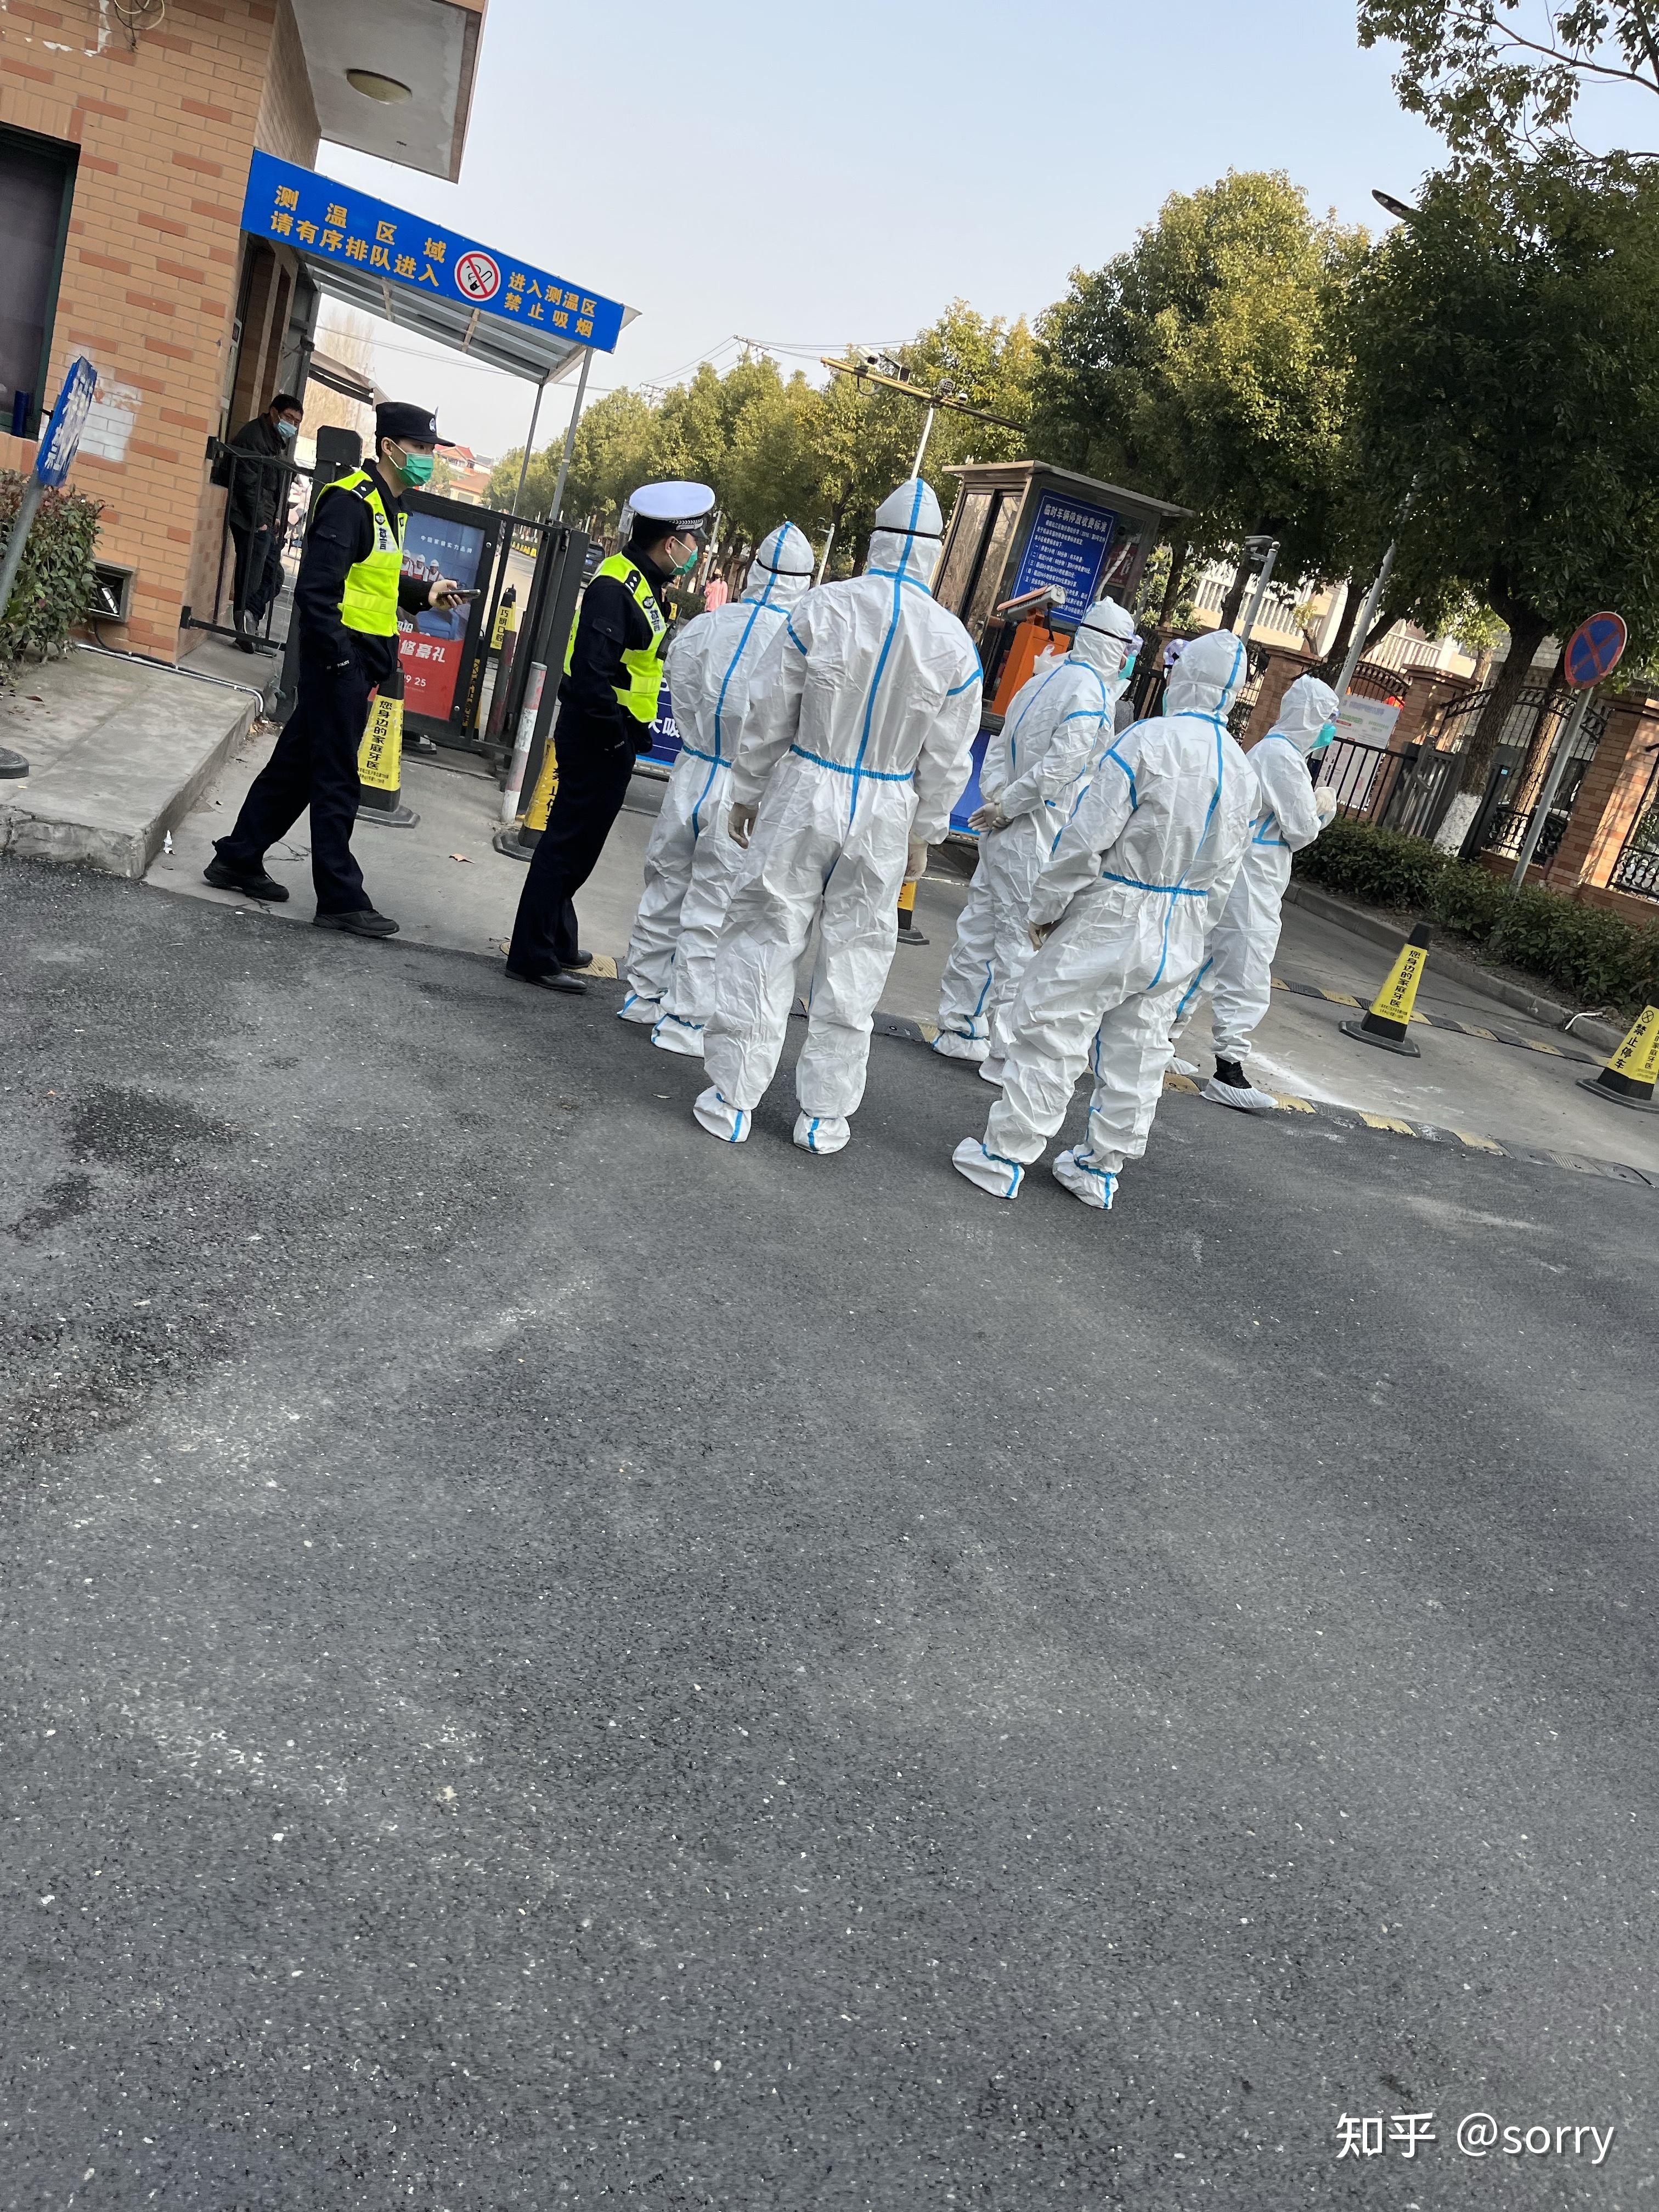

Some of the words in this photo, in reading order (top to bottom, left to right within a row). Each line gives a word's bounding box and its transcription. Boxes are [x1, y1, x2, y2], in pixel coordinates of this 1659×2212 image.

[274, 185, 447, 263] 测温区域
[270, 211, 439, 287] 请有序排队进入
[504, 292, 593, 338] 禁止吸烟
[508, 272, 597, 317] 进入测温区
[1043, 504, 1107, 533] 临时车辆停放收费标准
[399, 639, 445, 663] 修豪礼
[414, 677, 426, 687] 25
[366, 700, 393, 771] 您身边的家庭牙医
[1390, 950, 1421, 1008] 您身边的家庭牙医
[1614, 1024, 1647, 1069] 禁止停车
